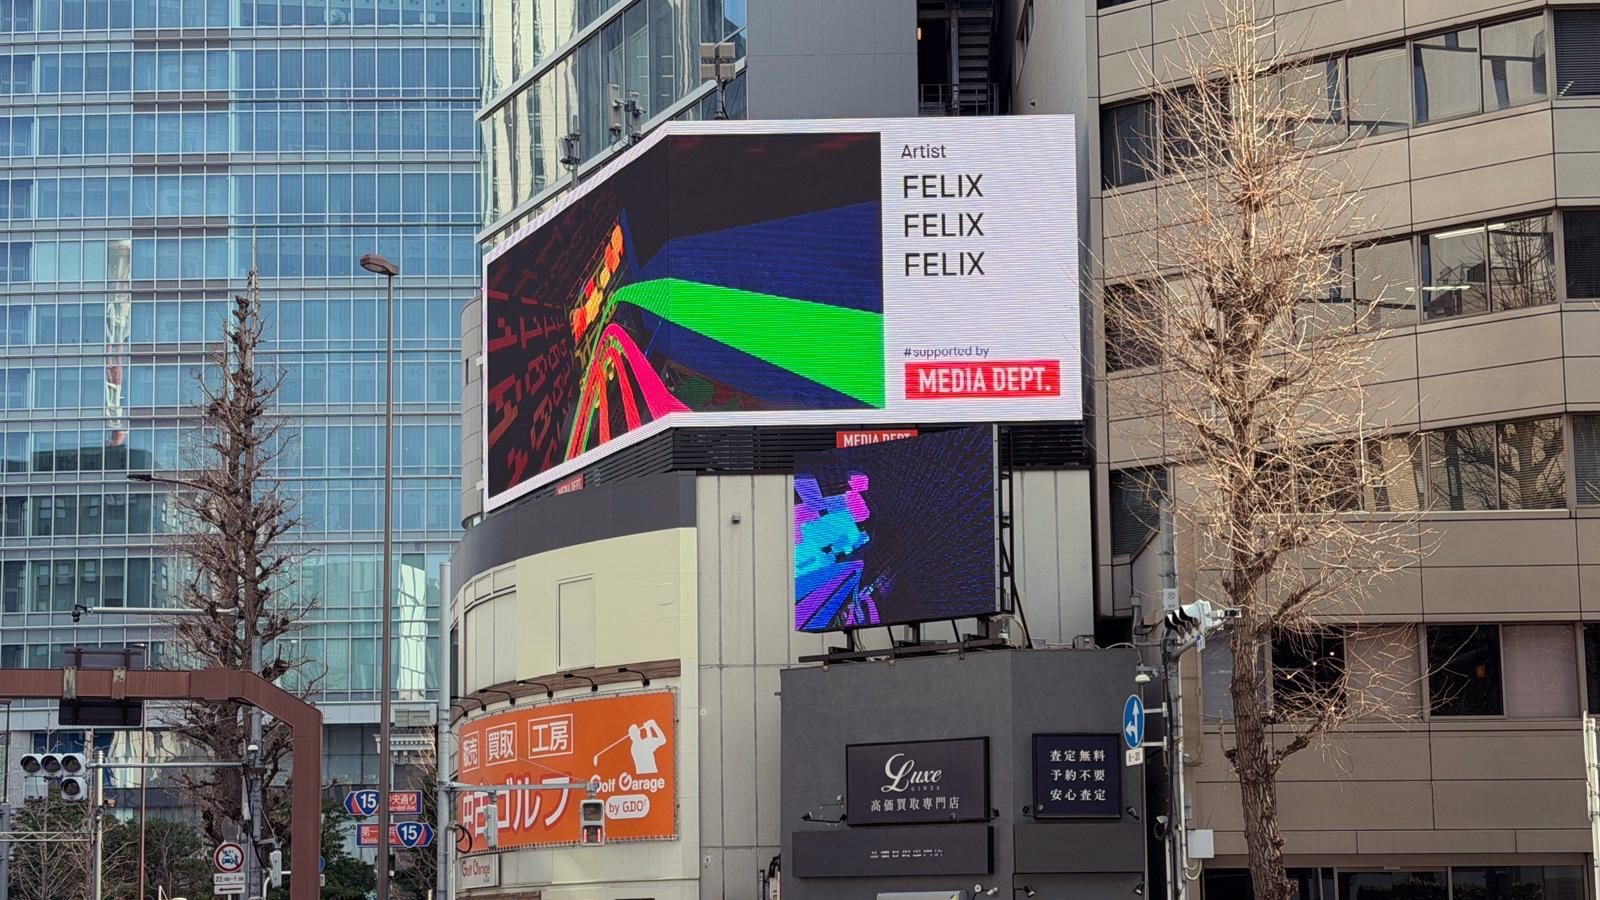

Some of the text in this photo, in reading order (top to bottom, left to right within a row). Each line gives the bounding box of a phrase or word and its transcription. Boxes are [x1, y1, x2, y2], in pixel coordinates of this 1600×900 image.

[901, 144, 947, 159] Artist
[903, 174, 984, 199] FELIX
[904, 212, 985, 237] FELIX
[905, 251, 986, 277] FELIX
[904, 346, 990, 359] #supported by
[918, 366, 1052, 393] MEDIA DEPT.
[488, 729, 514, 761] 買取
[532, 720, 568, 752] 工房
[1049, 749, 1105, 762] 査定無料
[880, 753, 943, 793] Luxe
[1049, 769, 1105, 782] 予約不要
[618, 772, 666, 793] Garage
[360, 793, 377, 809] 15
[1050, 788, 1106, 801] 安心査定
[608, 802, 620, 815] by
[870, 795, 960, 813] 高価買取専門店
[401, 825, 418, 841] 15
